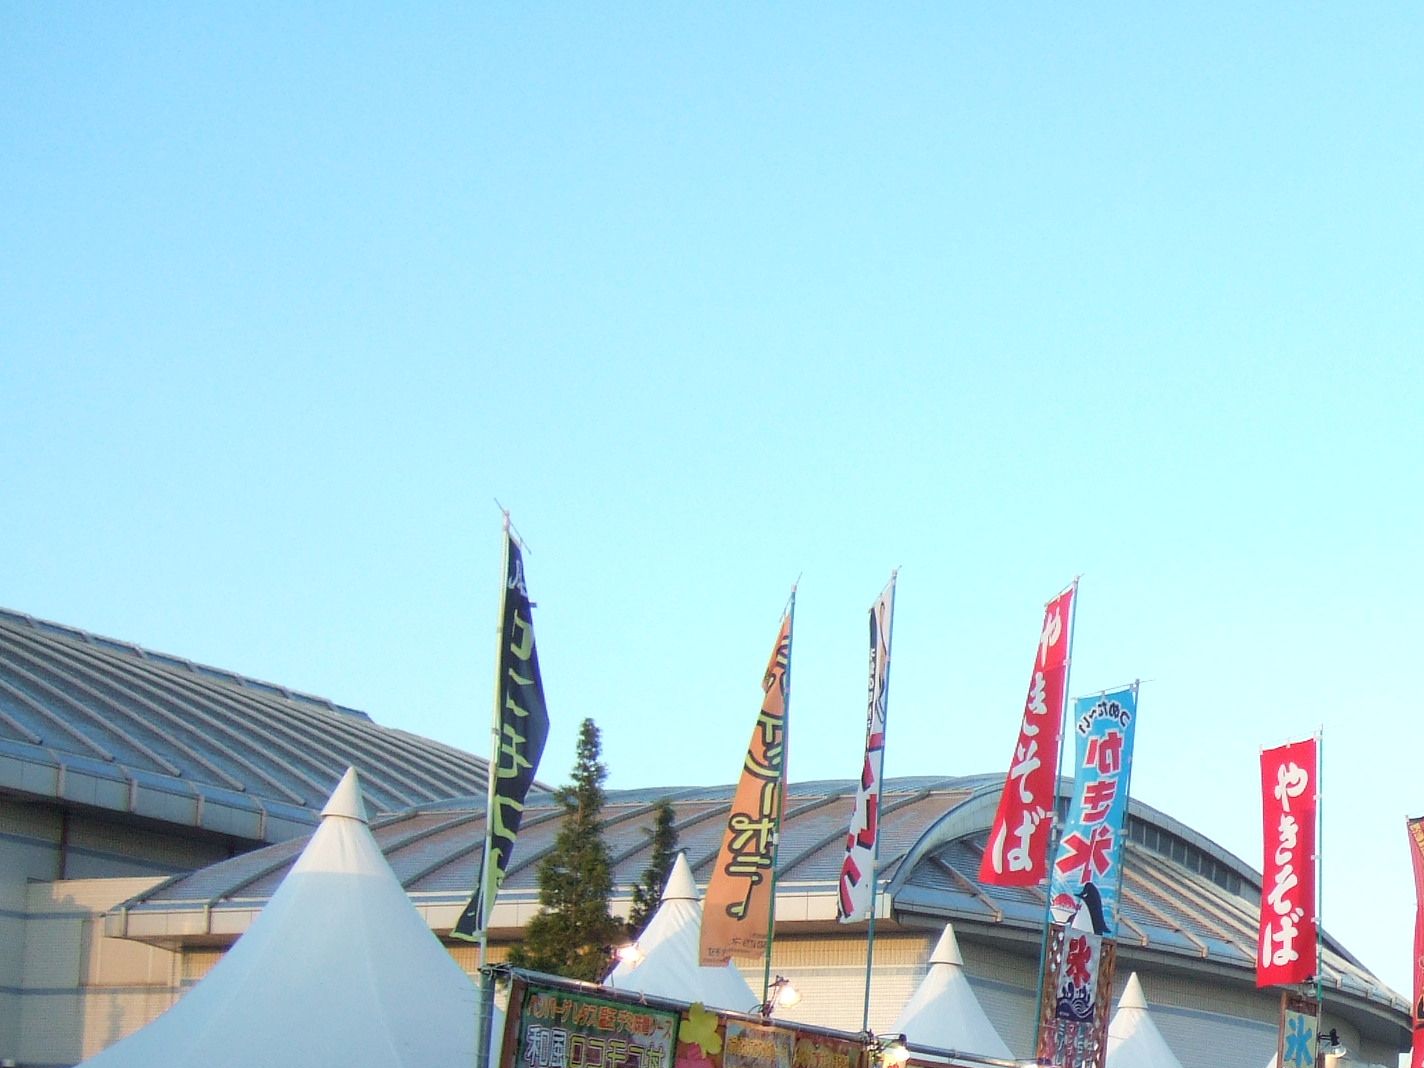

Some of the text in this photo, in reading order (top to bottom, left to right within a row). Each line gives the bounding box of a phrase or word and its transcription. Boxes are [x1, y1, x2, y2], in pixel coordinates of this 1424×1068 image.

[992, 607, 1062, 874] やきそば
[1261, 762, 1310, 968] やきそば
[1285, 1014, 1313, 1068] 氷
